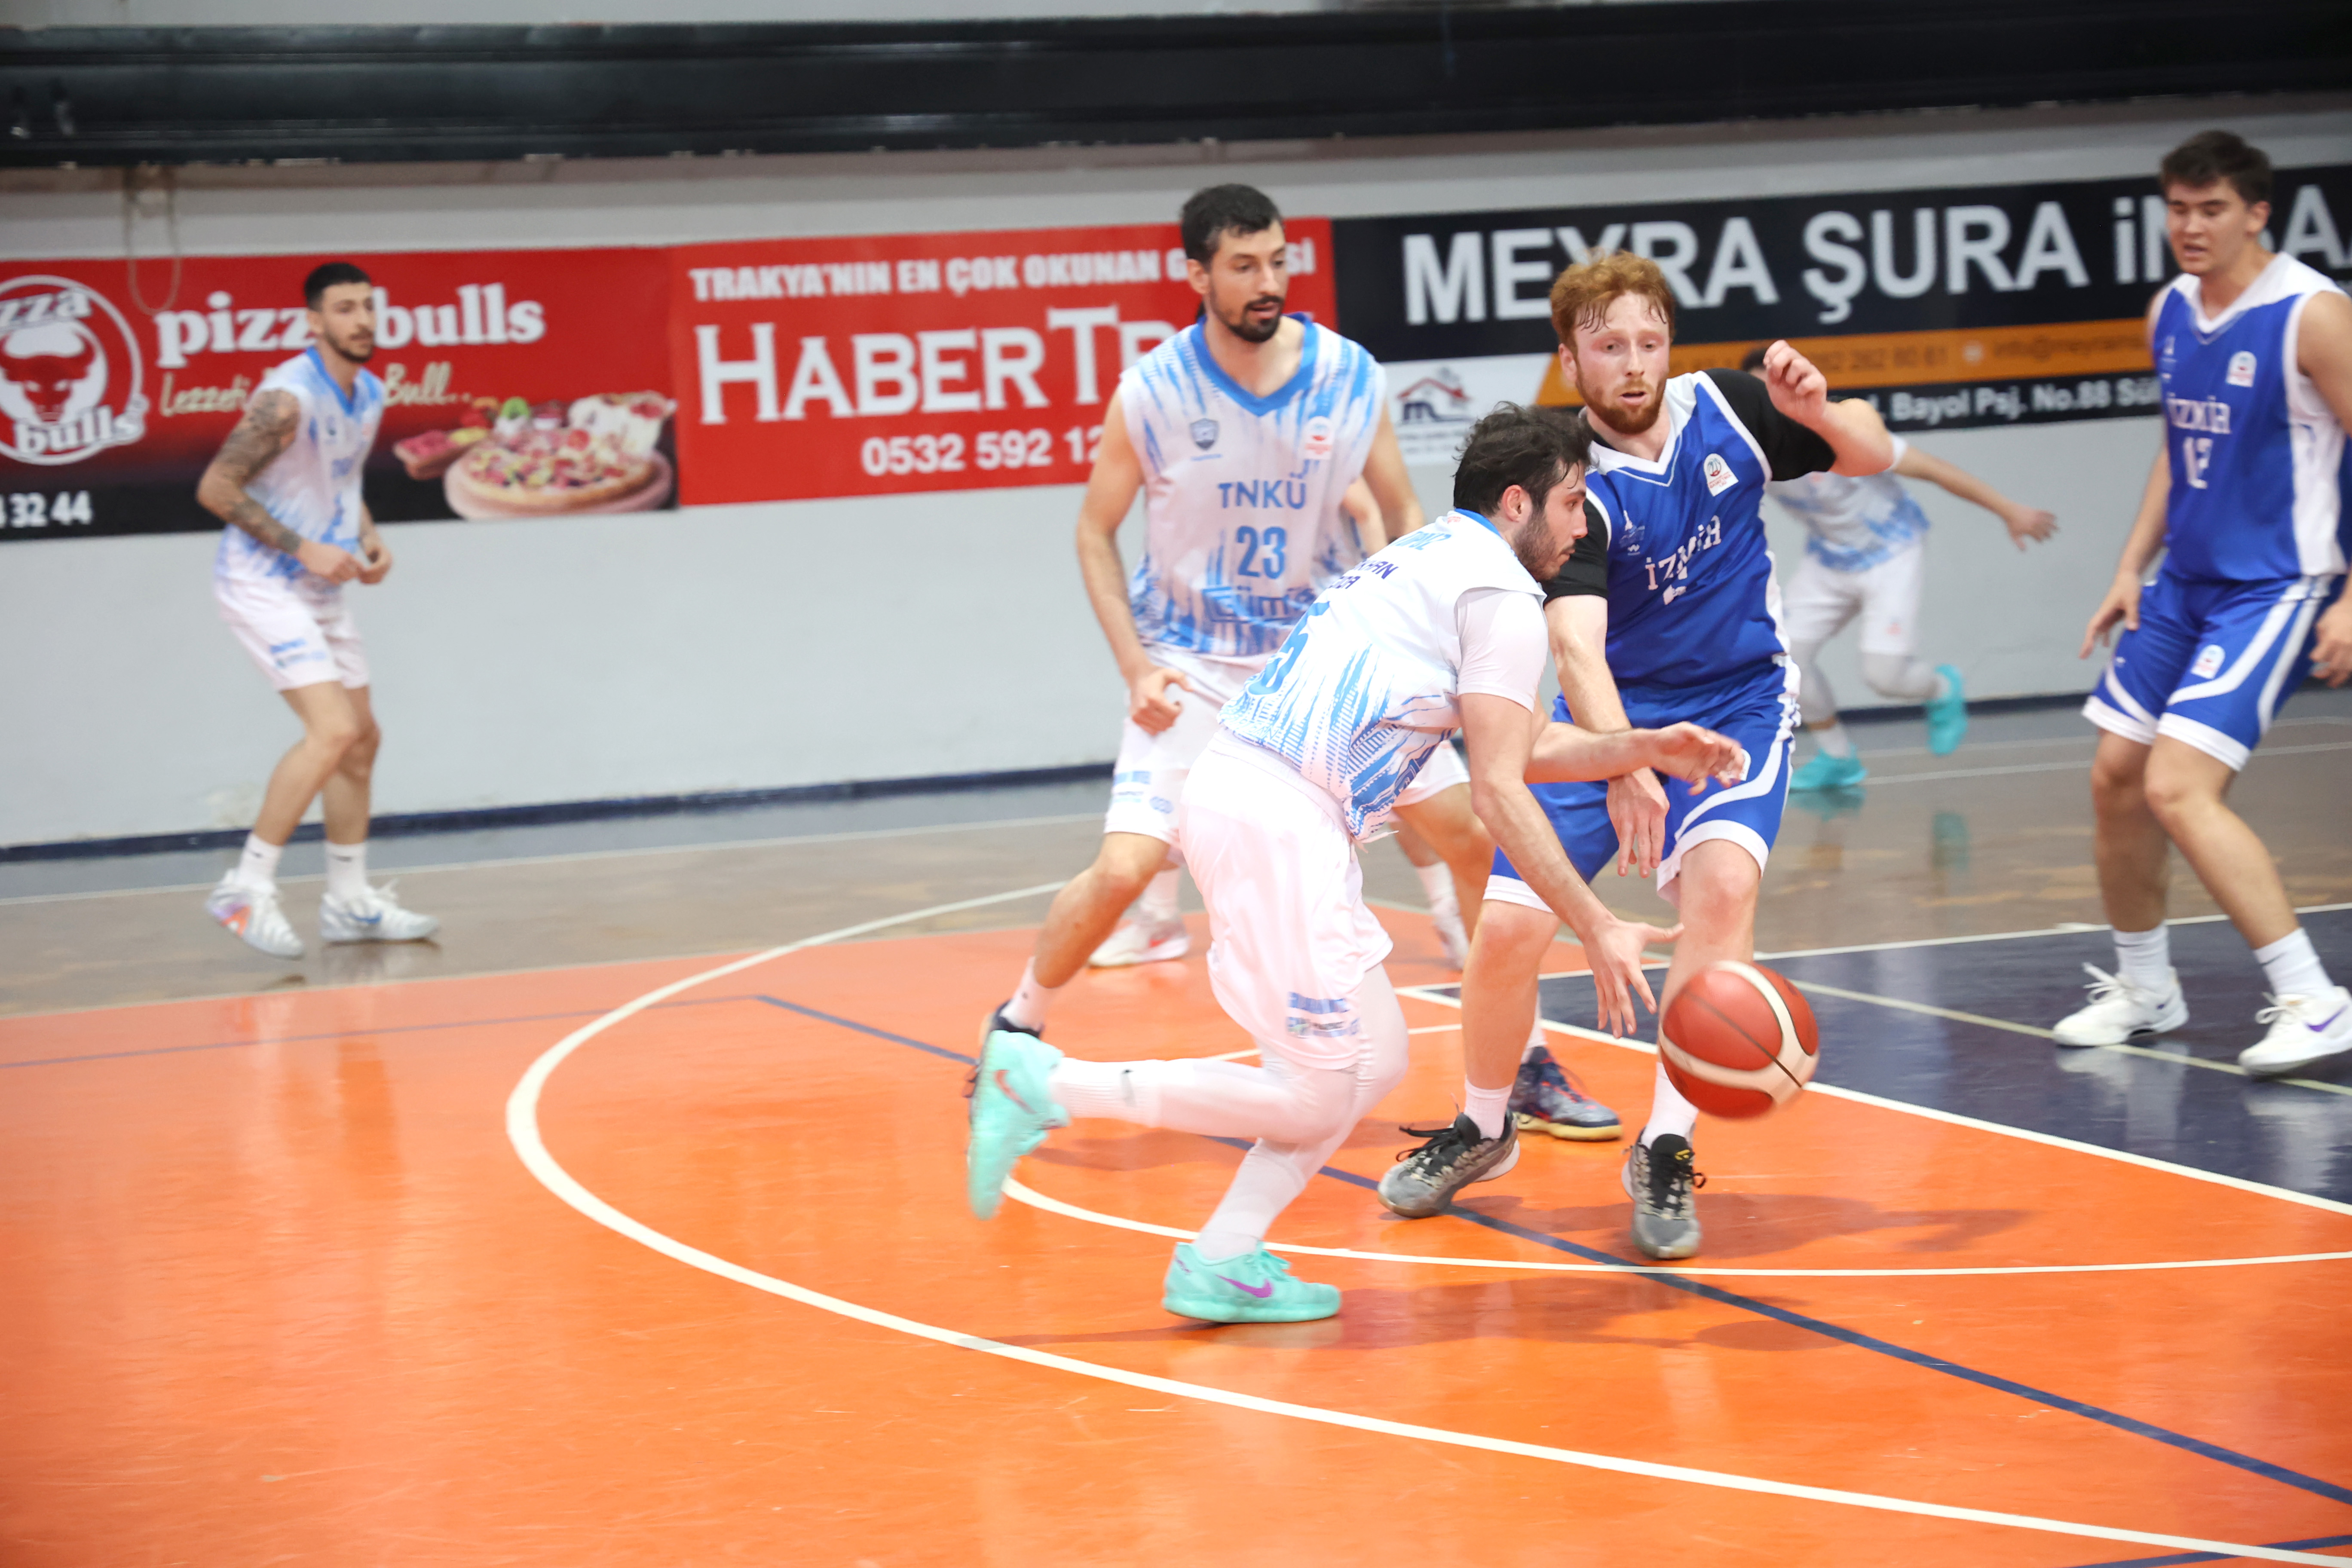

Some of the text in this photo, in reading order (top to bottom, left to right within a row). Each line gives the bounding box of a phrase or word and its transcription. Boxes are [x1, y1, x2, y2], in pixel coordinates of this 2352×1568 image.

[689, 261, 891, 302] TRAKYA'NIN
[896, 259, 940, 294] EN
[948, 255, 1019, 297] ÇOK
[1024, 248, 1161, 288] OKUNAN
[1403, 216, 1779, 325] MEYRA
[1803, 200, 2089, 325] ŞURA
[0, 287, 92, 328] zza
[154, 282, 546, 369] pizz bulls
[862, 434, 965, 475] 0532
[975, 429, 1053, 470] 592
[9, 493, 48, 528] 32
[51, 490, 93, 525] 44
[1217, 471, 1307, 509] TNKÜ
[1236, 525, 1286, 579] 23
